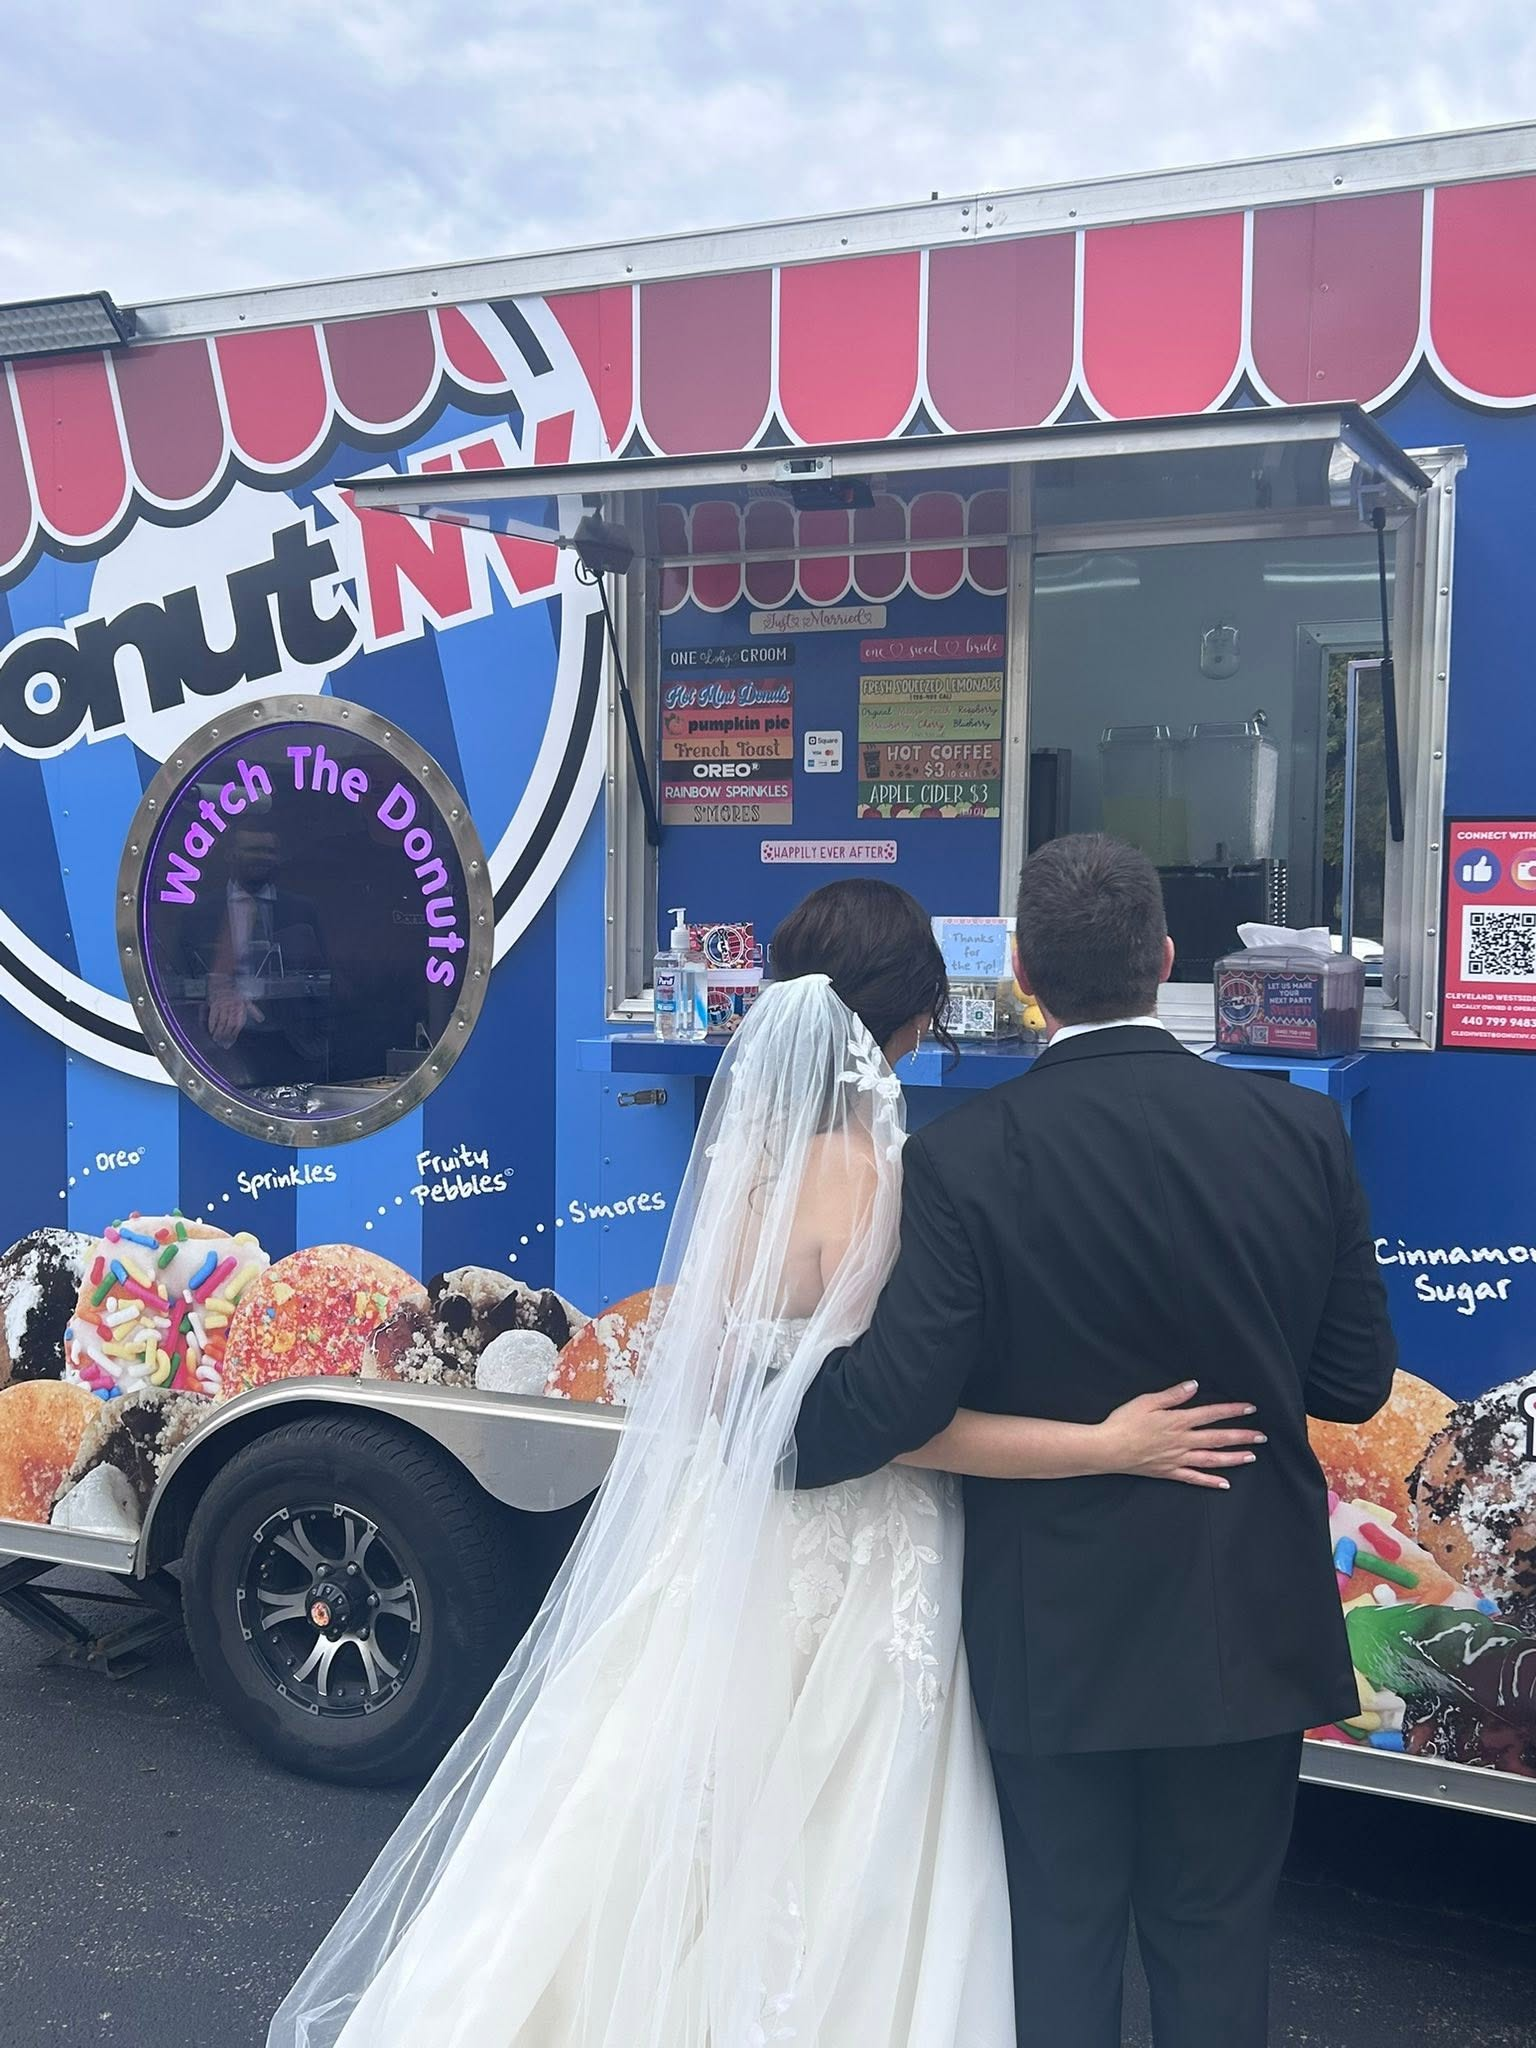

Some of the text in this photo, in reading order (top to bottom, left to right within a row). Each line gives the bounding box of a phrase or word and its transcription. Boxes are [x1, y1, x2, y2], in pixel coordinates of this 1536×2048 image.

[765, 608, 871, 631] Just Married
[966, 635, 998, 653] bride
[671, 651, 697, 665] ONE
[740, 647, 787, 663] GROOM
[738, 682, 791, 708] Donuts
[863, 677, 1000, 695] FRESH SQUEEZED LEMONADE
[688, 714, 790, 734] pumpkin pie
[674, 739, 781, 758] French Toast
[818, 737, 838, 745] Square
[887, 744, 992, 760] HOT COFFEE
[923, 761, 945, 778] $3
[665, 784, 788, 798] RAINBOW SPRINKLES
[870, 783, 988, 803] APPLE CIDER $3
[694, 804, 760, 823] S'MORES
[1457, 831, 1536, 840] CONNECT WITH
[774, 846, 883, 859] HAPPILY EVER AFTER
[160, 744, 465, 987] Watch The Donuts
[953, 933, 994, 943] Thanks
[964, 947, 981, 957] for
[951, 960, 996, 974] the Tip!
[1445, 992, 1536, 1002] CLEVELAND WESTSIDE
[1461, 1016, 1536, 1028] 440 799 9483
[416, 1143, 489, 1176] Fruity
[237, 1164, 337, 1200] Sprinkles
[569, 1192, 666, 1223] S'mores
[1374, 1237, 1536, 1265] Cinnamo
[1415, 1274, 1511, 1315] Sugar
